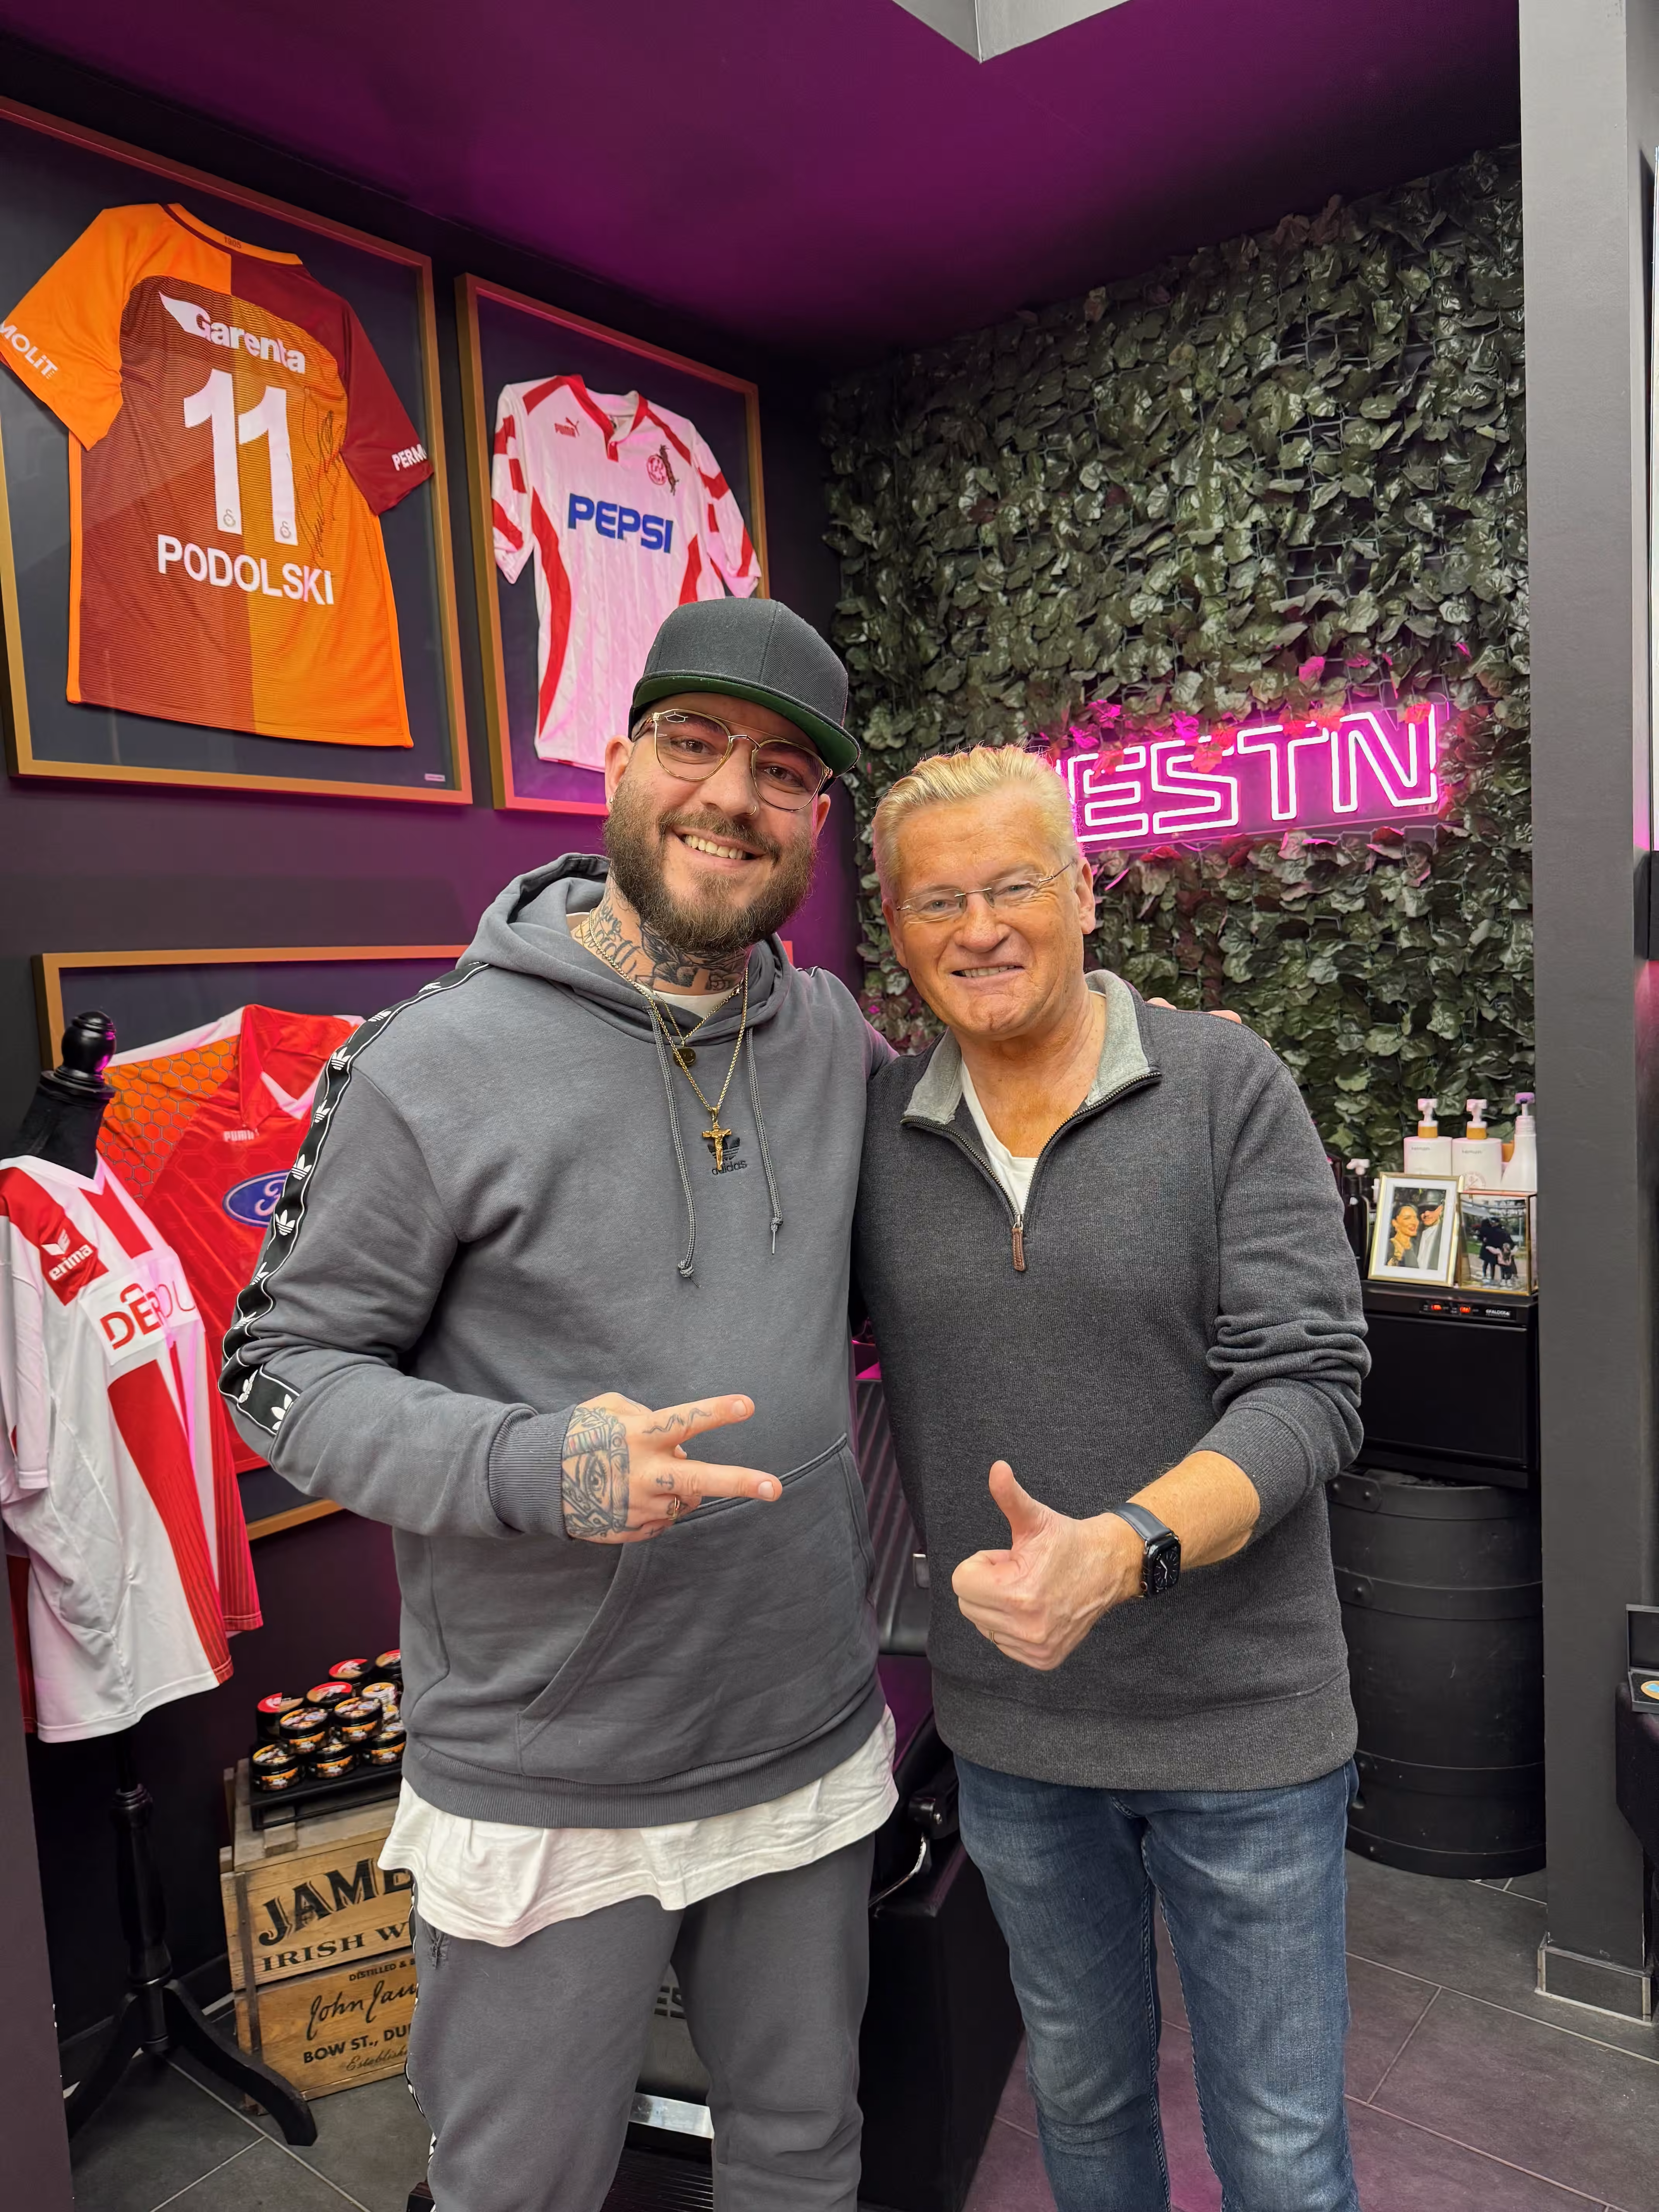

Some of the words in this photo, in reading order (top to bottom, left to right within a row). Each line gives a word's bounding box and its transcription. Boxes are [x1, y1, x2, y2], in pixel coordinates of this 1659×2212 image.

[189, 301, 305, 374] Garenta
[184, 369, 298, 546] 11
[391, 444, 427, 471] PERM
[568, 493, 673, 554] PEPSI
[158, 534, 334, 605] PODOLSKI
[1056, 702, 1438, 842] ESTN
[49, 1244, 94, 1281] erima
[262, 1933, 366, 1971] IRISH
[349, 1963, 396, 1981] DISTILLED
[306, 1991, 364, 2040] John
[304, 2042, 346, 2063] BOW
[384, 2023, 411, 2042] DU
